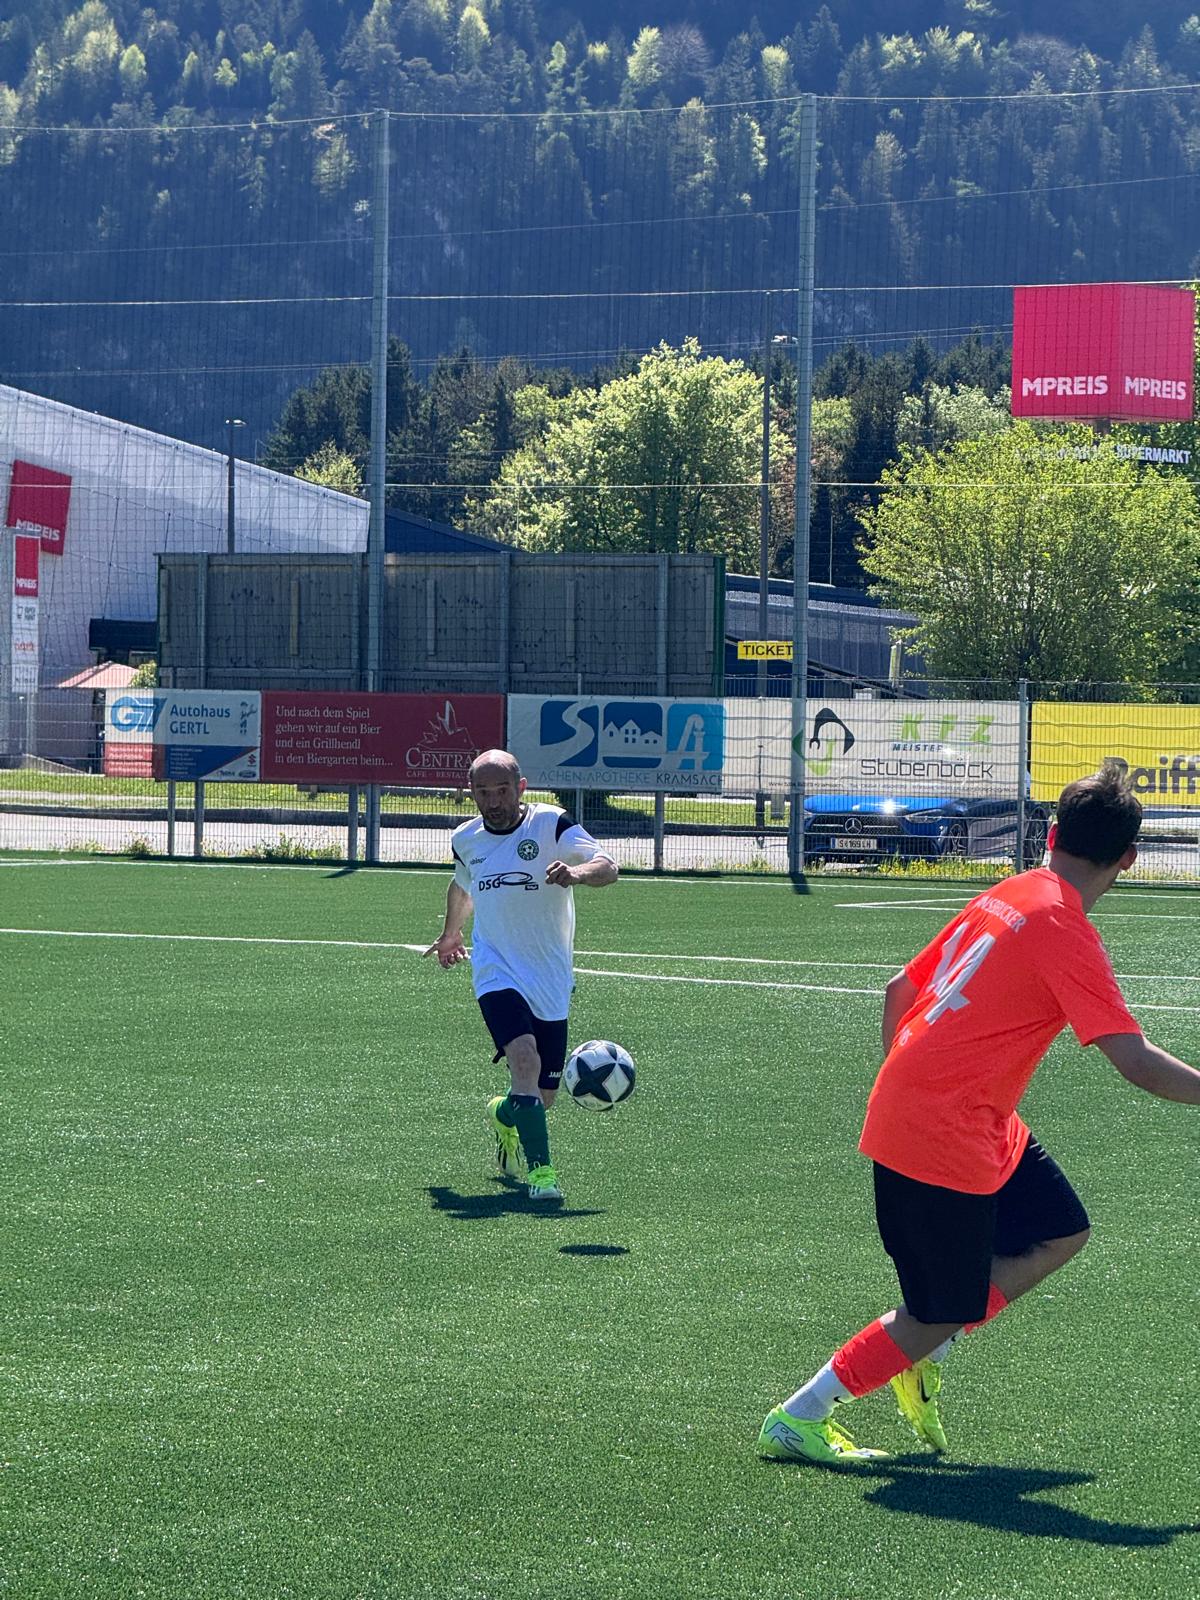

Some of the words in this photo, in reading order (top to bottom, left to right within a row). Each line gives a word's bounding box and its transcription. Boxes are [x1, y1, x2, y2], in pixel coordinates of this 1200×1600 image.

[1022, 375, 1109, 397] MPREIS
[1124, 375, 1187, 401] MPREIS
[743, 645, 793, 656] TICKET
[170, 704, 230, 719] Autohaus
[276, 705, 296, 717] Und
[298, 706, 320, 718] nach
[322, 707, 344, 719] dem
[346, 707, 370, 721] Spiel
[170, 721, 210, 735] GERTL
[275, 721, 305, 735] gehen
[307, 722, 324, 733] wir
[325, 722, 341, 734] auf
[342, 723, 357, 734] ein
[360, 723, 382, 735] Bier
[275, 737, 293, 748] und
[295, 737, 310, 749] ein
[313, 738, 361, 750] Grillhendl
[275, 752, 284, 763] in
[286, 753, 304, 764] den
[307, 753, 358, 767] Biergarten
[861, 757, 994, 780] Stubenböck
[479, 876, 502, 892] DSG
[925, 920, 996, 1026] 14
